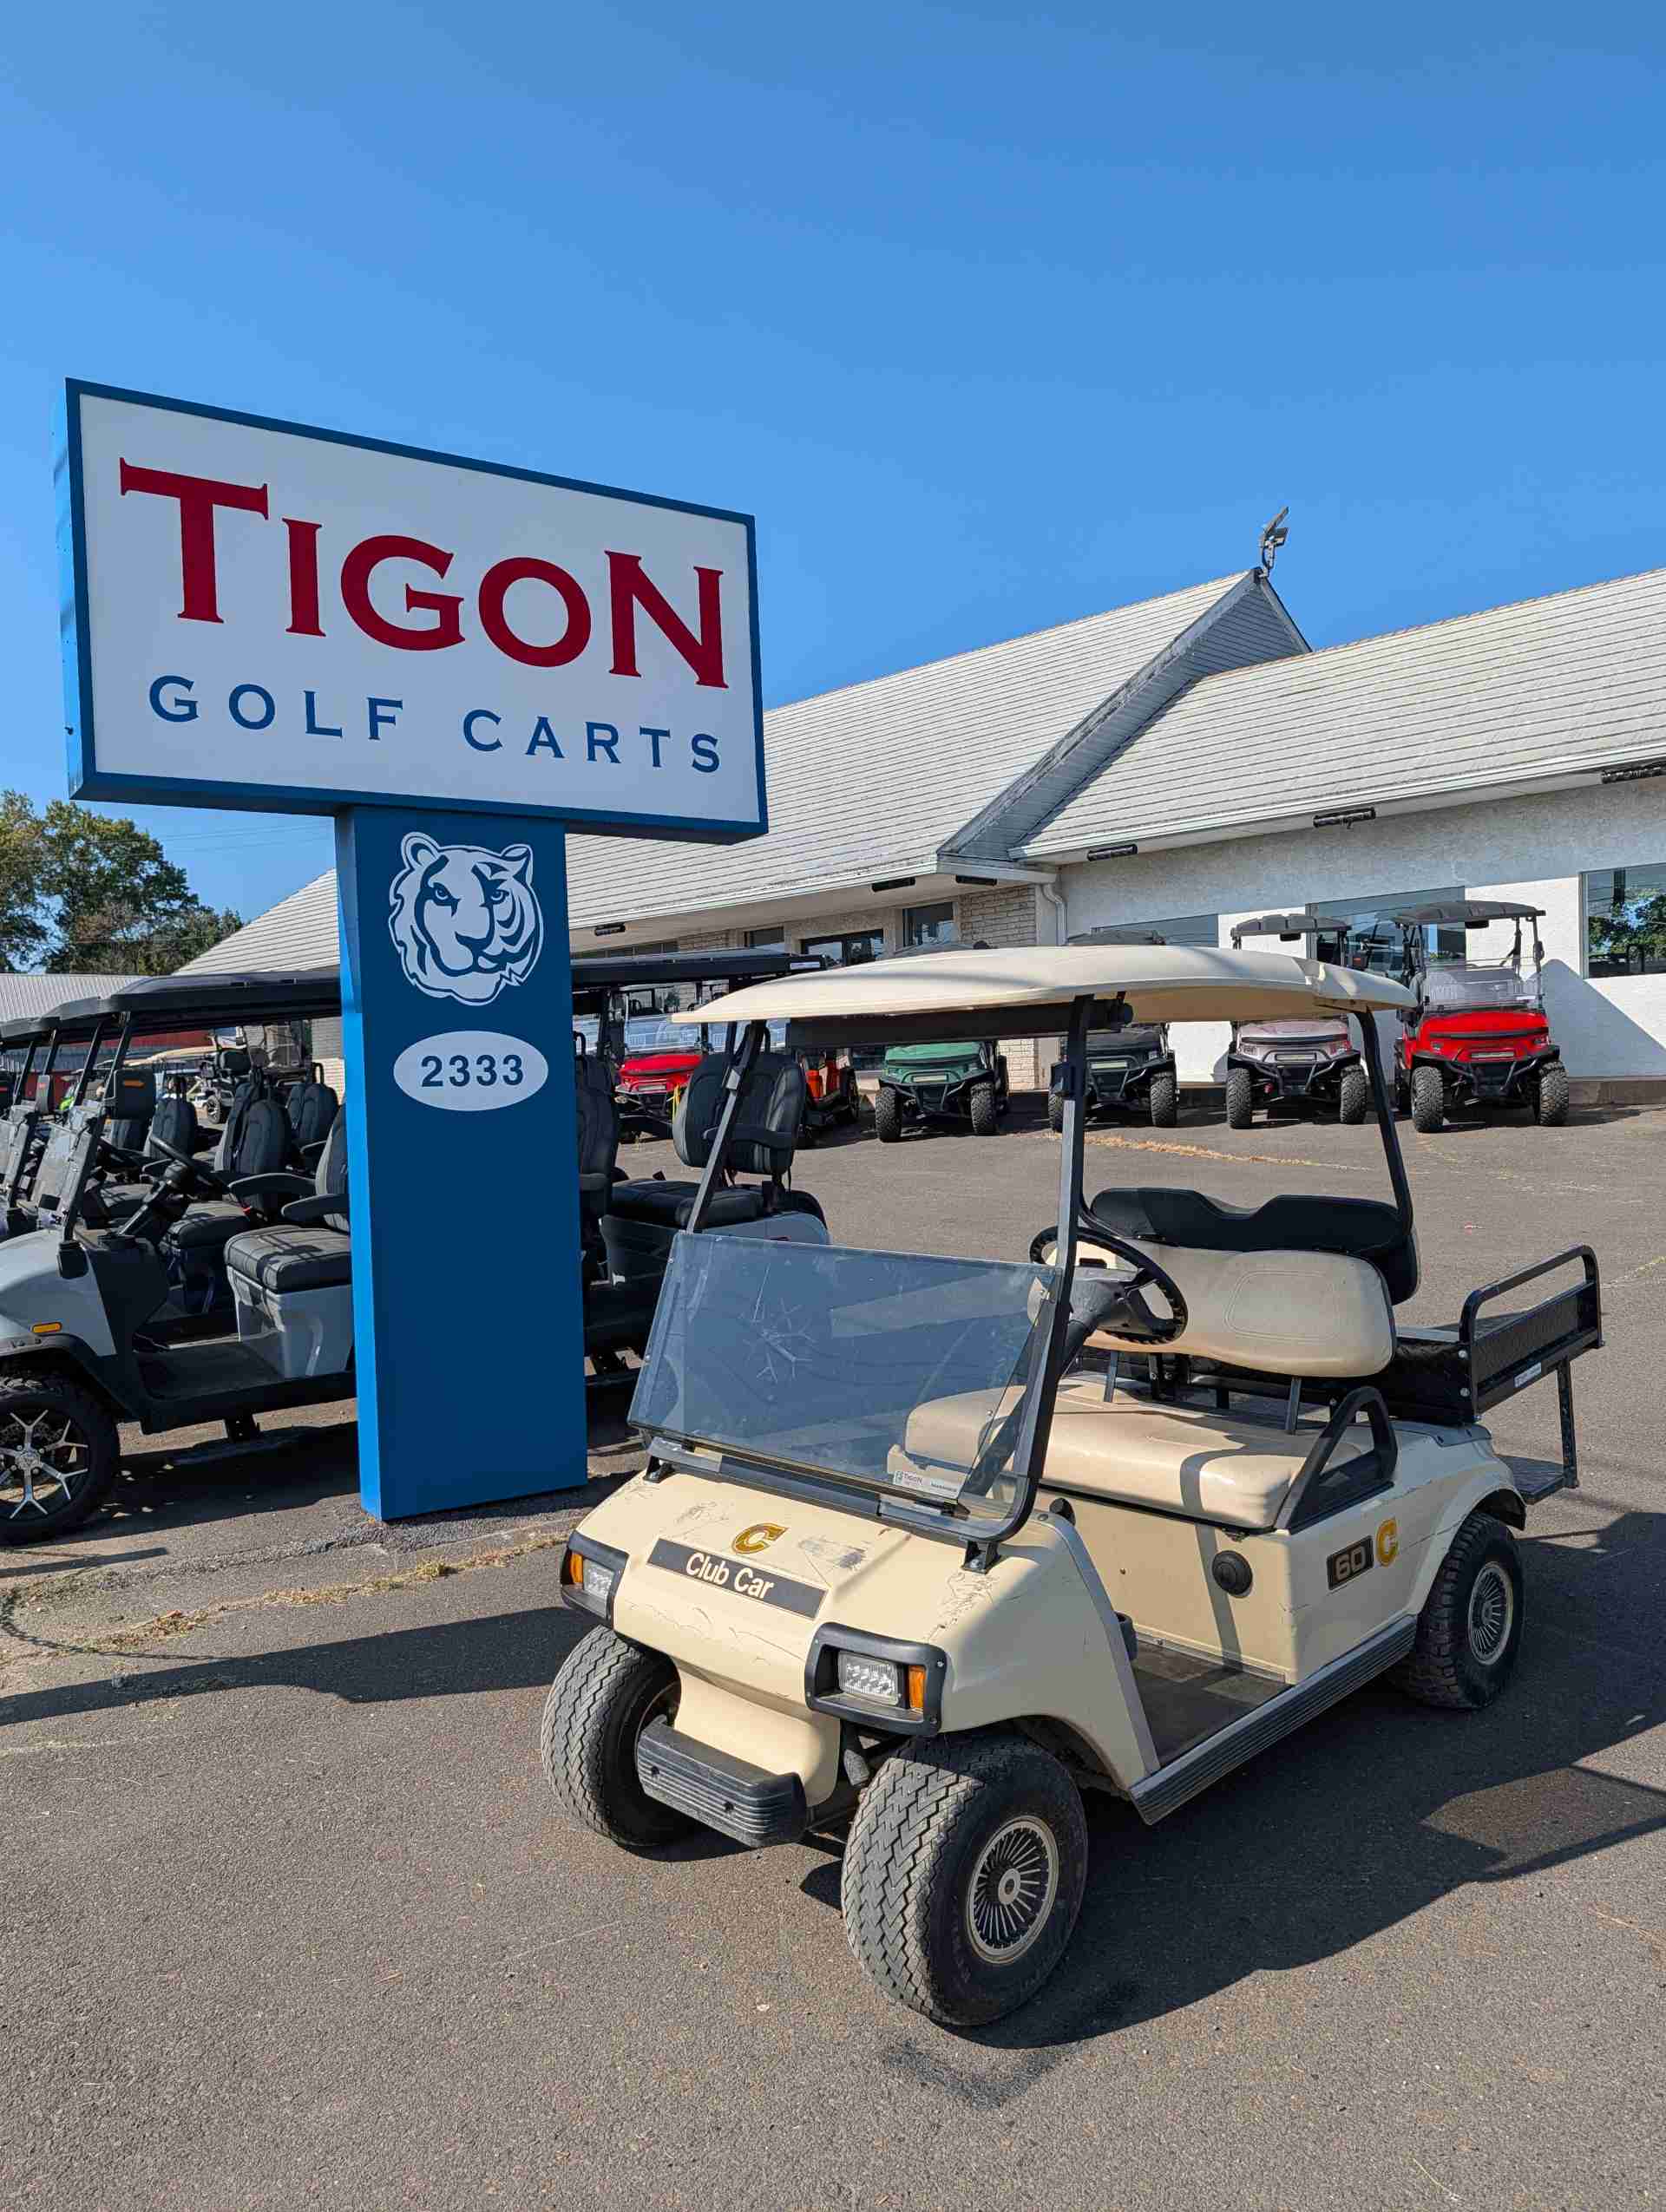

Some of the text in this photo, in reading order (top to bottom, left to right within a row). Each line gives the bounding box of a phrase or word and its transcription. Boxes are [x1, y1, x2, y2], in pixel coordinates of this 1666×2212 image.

[120, 457, 727, 690] TIGON
[149, 674, 720, 774] GOLF CARTS
[421, 1054, 524, 1088] 2333
[685, 1552, 775, 1599] Club Car
